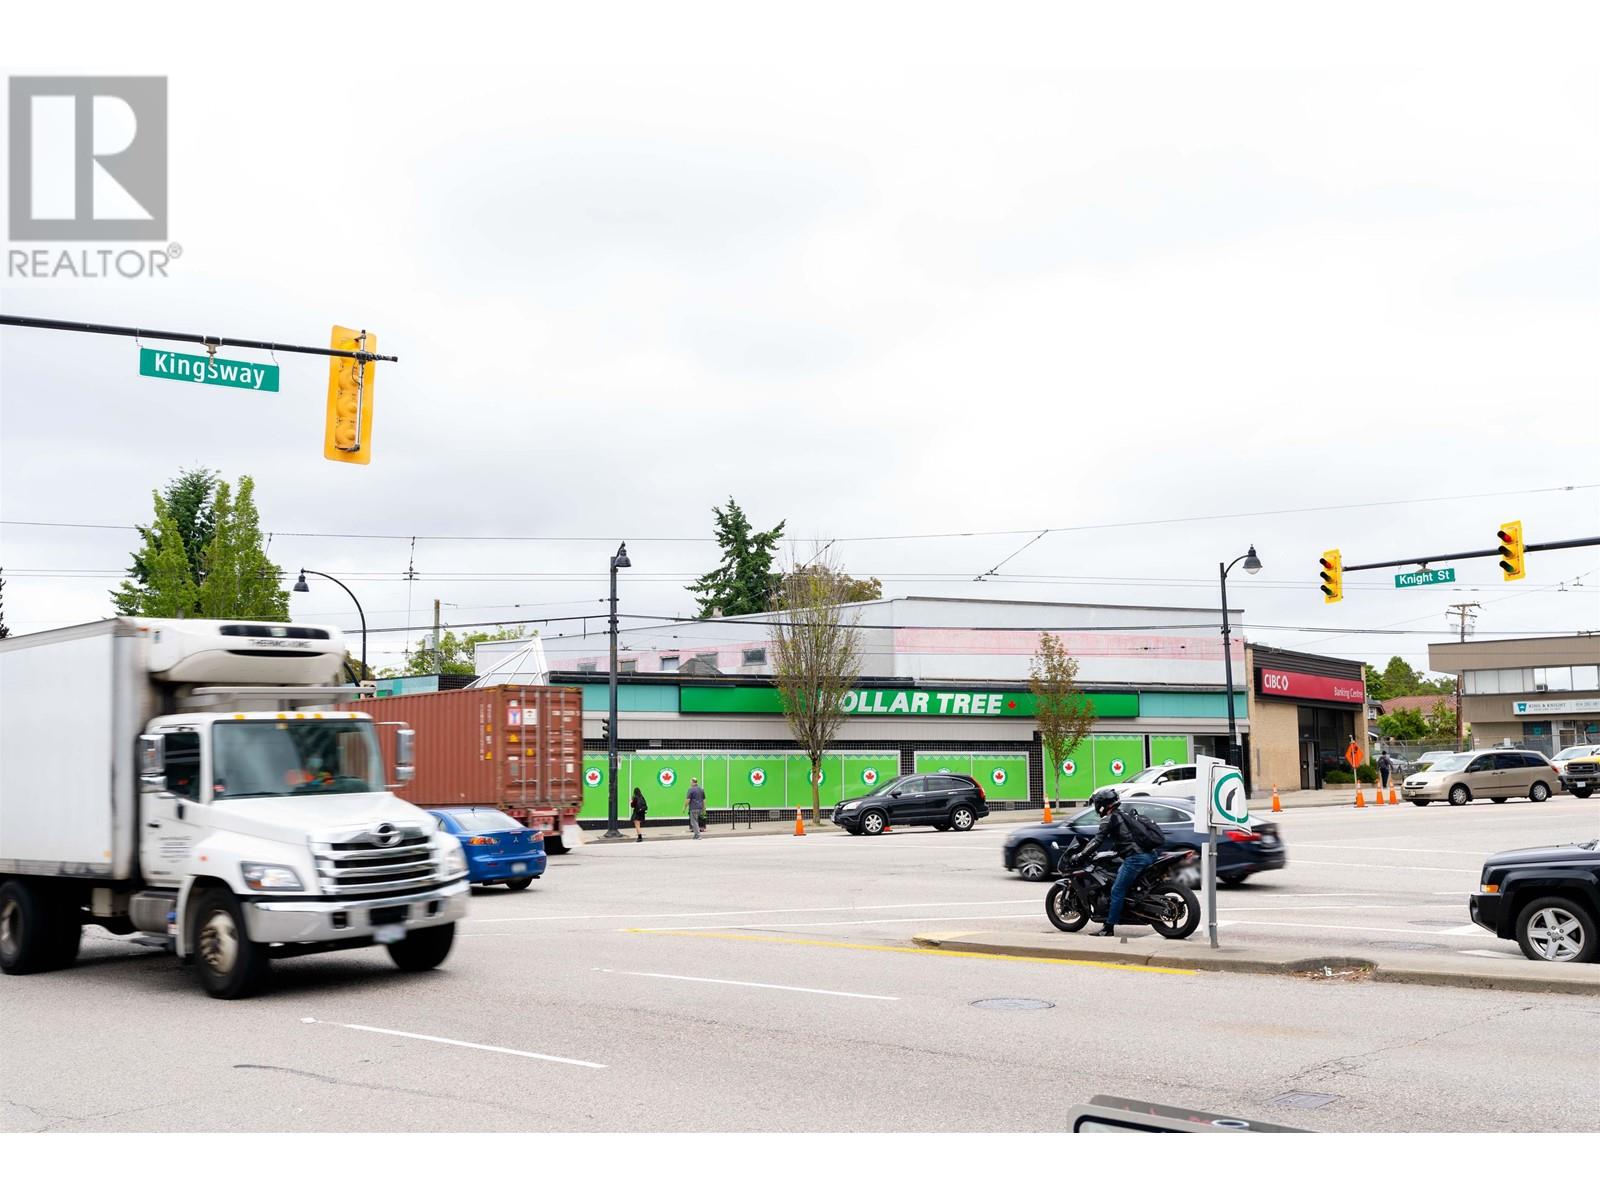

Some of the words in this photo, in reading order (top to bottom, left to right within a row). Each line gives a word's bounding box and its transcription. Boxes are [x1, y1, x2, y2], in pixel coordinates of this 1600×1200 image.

[155, 352, 265, 389] Kingsway
[1400, 572, 1433, 584] Knight
[1437, 570, 1450, 580] St
[1264, 673, 1282, 689] CIBC
[1334, 686, 1350, 699] Banking
[936, 693, 1004, 714] TREE
